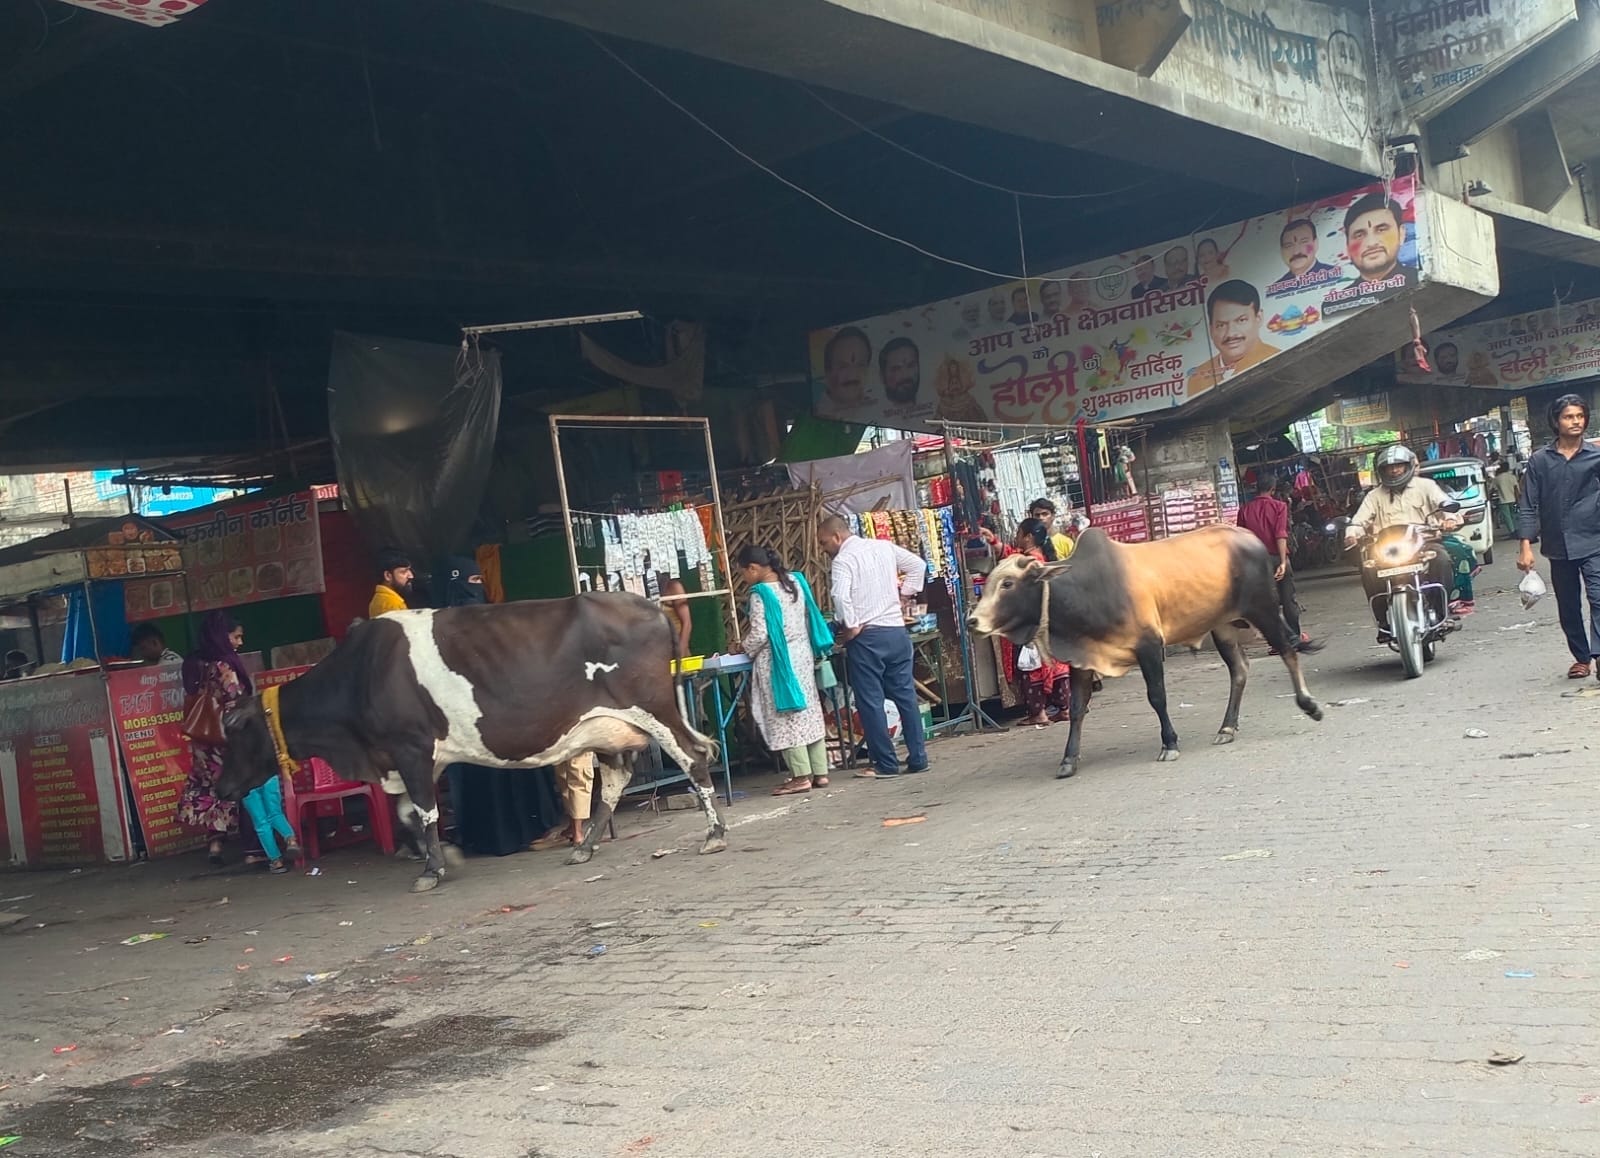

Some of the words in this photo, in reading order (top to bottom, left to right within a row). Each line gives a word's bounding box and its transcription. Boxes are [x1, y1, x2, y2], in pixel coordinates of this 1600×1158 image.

[1323, 287, 1358, 303] नीरज
[1360, 279, 1385, 296] सिंह
[1387, 274, 1406, 287] जी
[968, 330, 1014, 356] आप
[1020, 315, 1071, 344] सभी
[1078, 276, 1209, 331] क्षेत्रवासियों
[1032, 346, 1049, 360] को
[1487, 338, 1512, 351] आप
[1491, 347, 1549, 382] होली
[977, 350, 1079, 424] होली
[1083, 354, 1102, 371] की
[1129, 351, 1184, 380] हार्दिक
[1082, 373, 1185, 417] शुभकामनाएँ
[250, 493, 311, 528] कॉर्नर
[120, 691, 155, 716] FAST
[124, 729, 155, 741] MENU
